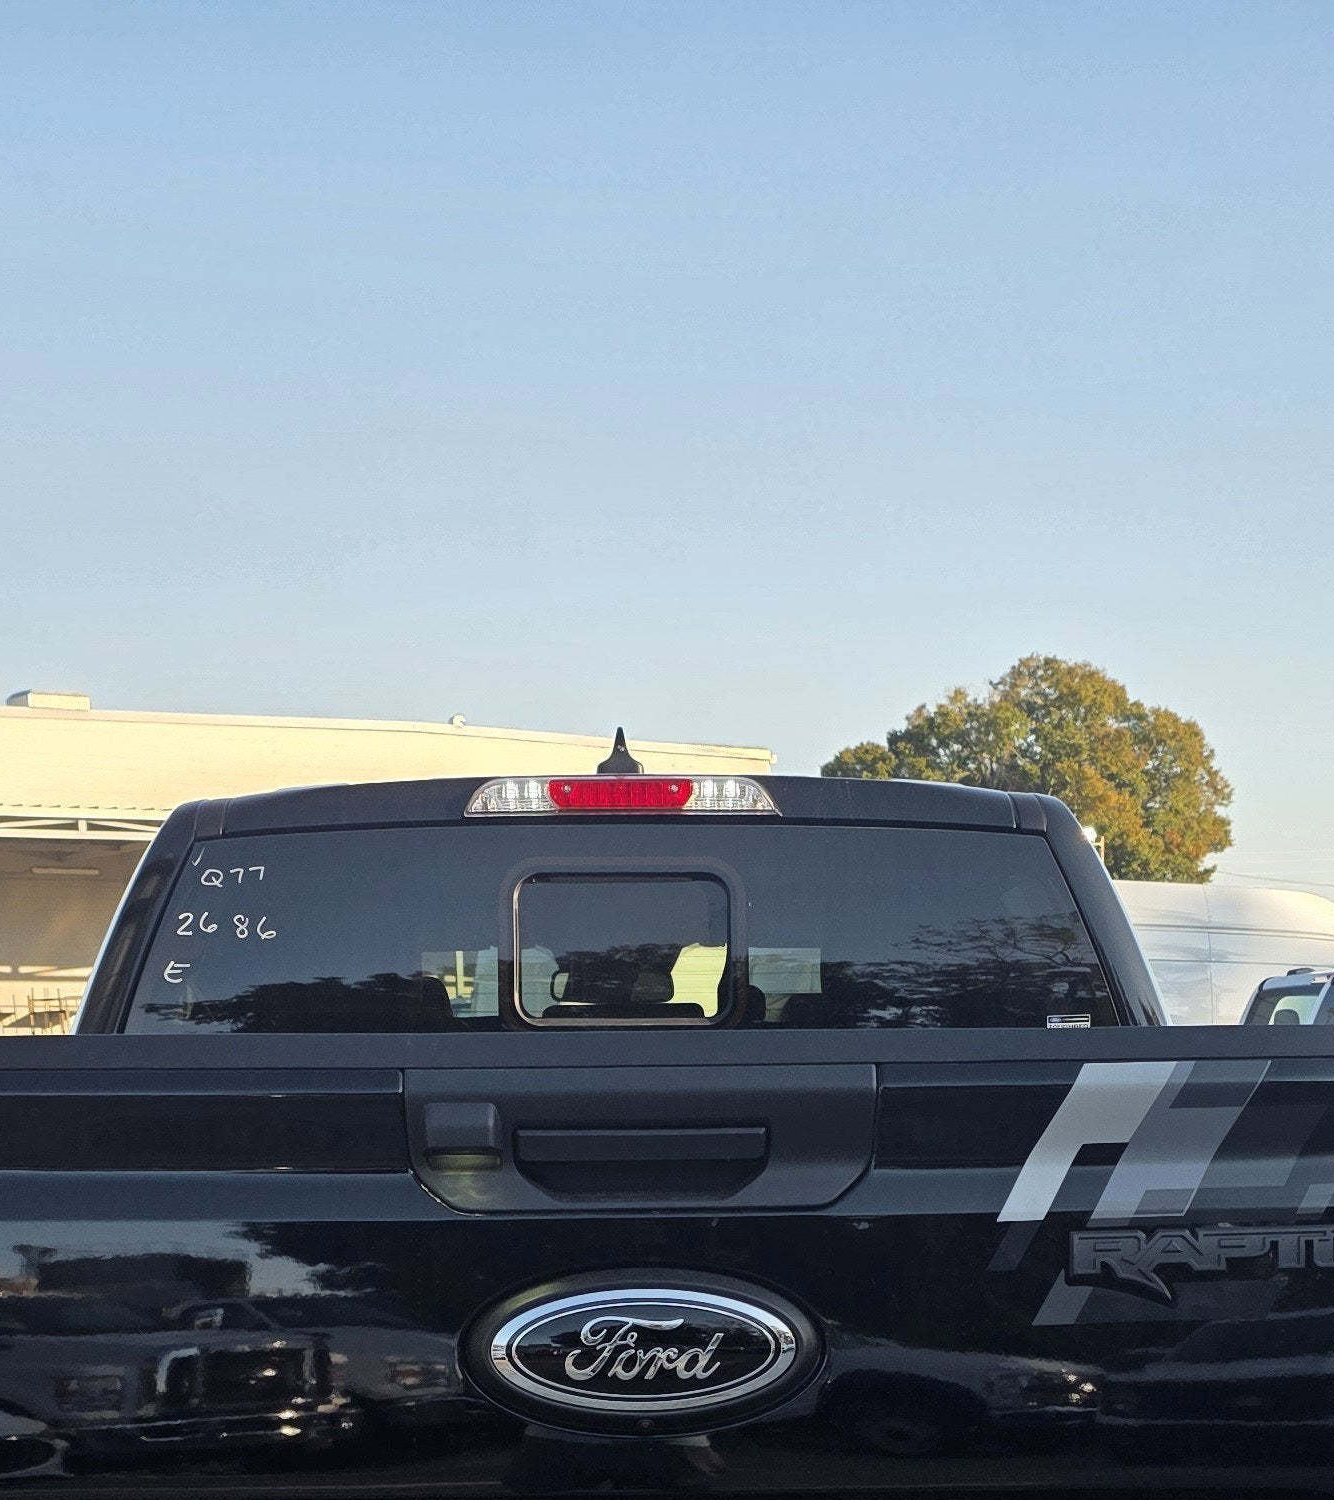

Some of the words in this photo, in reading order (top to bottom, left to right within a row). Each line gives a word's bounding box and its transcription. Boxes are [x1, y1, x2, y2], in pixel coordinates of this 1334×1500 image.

[200, 866, 265, 888] Q77
[163, 960, 191, 983] E
[565, 1315, 724, 1381] Ford
